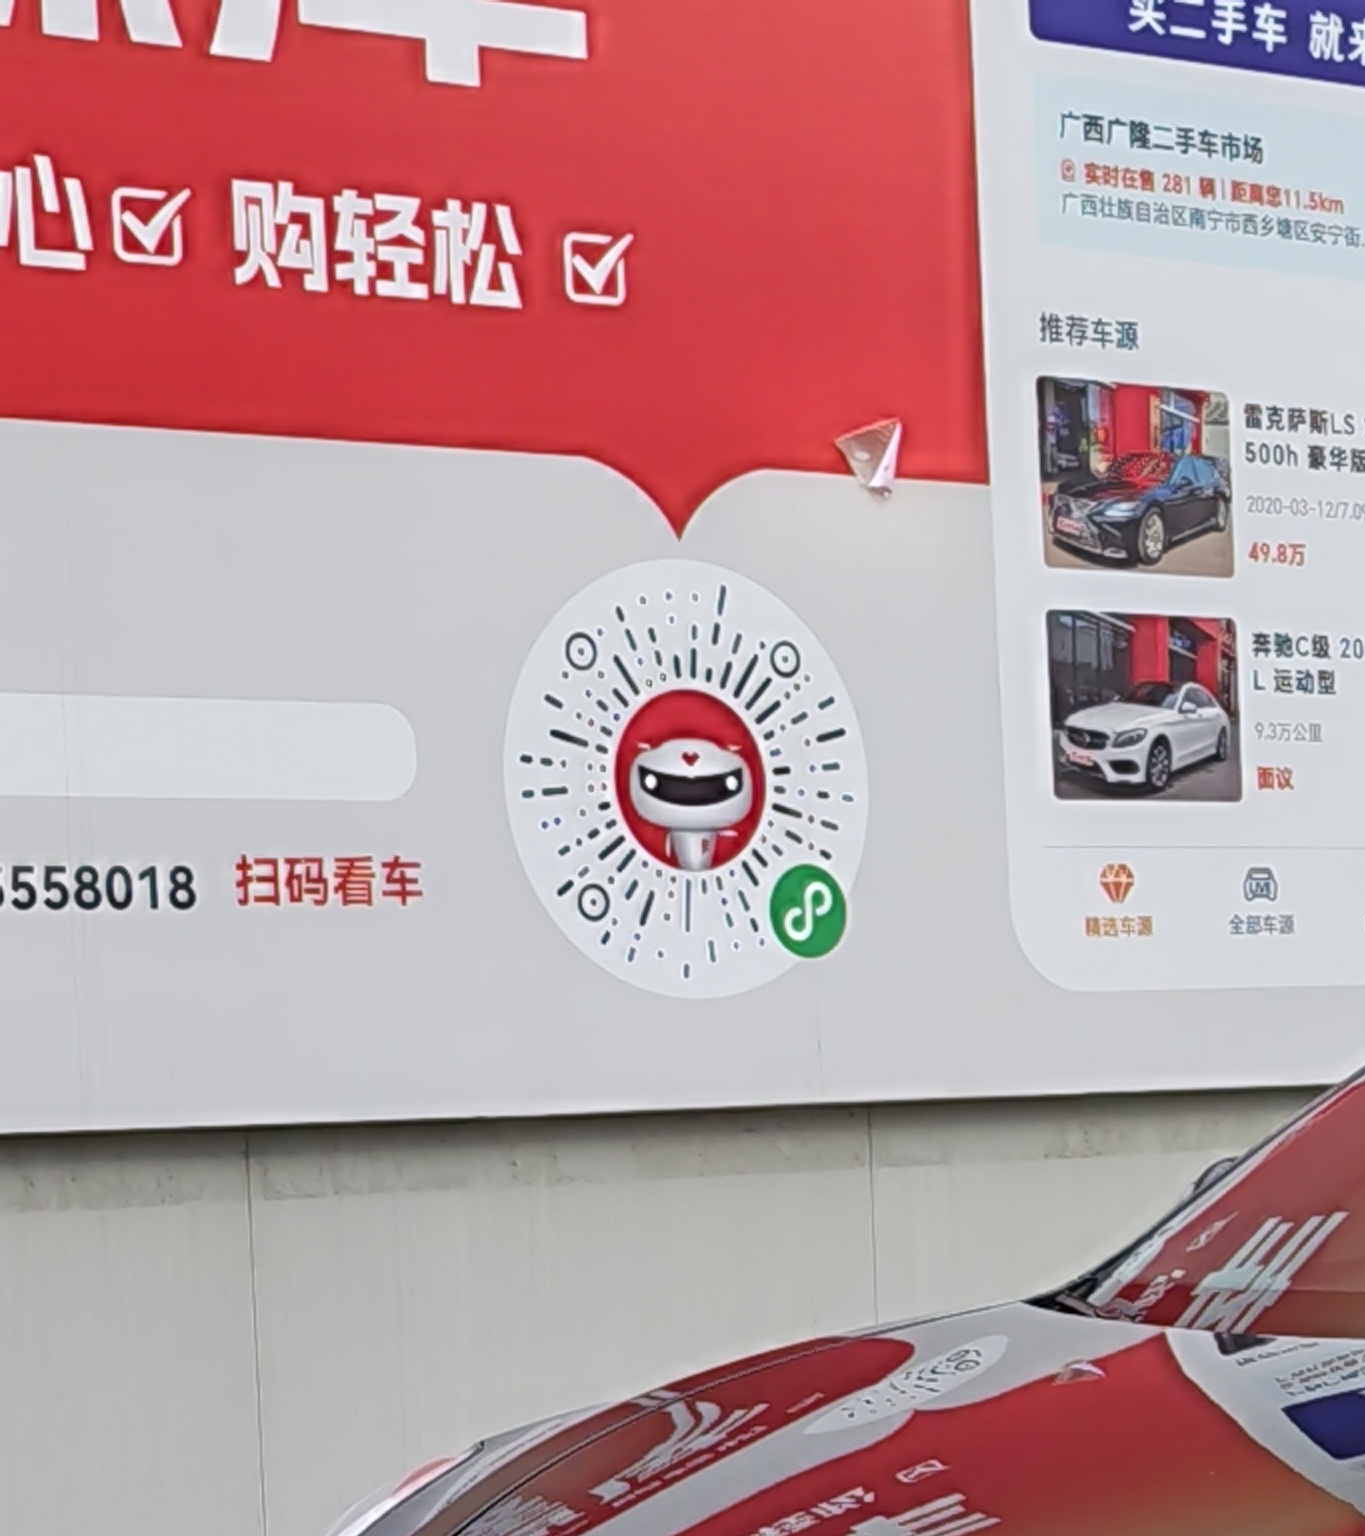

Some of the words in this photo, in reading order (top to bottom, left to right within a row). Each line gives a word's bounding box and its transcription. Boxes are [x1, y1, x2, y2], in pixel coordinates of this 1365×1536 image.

[1058, 110, 1265, 165] 广西广隆二手车市场
[1083, 160, 1156, 193] 实时在售
[1161, 172, 1193, 197] 281
[231, 178, 523, 310] 购轻松
[1039, 312, 1140, 351] 推荐车源
[1243, 402, 1355, 437] 雷克萨斯LS
[1245, 441, 1299, 468] 500h
[1247, 541, 1306, 567] 49.8万
[1251, 632, 1332, 660] 奔驰C级
[1252, 669, 1266, 691] L
[1273, 670, 1337, 695] 运动型
[1254, 722, 1323, 743] 9.3万公里
[1256, 766, 1295, 792] 面议
[234, 853, 424, 907] 扫码看车
[1085, 916, 1154, 937] 精选车源
[1229, 914, 1295, 935] 全部车源
